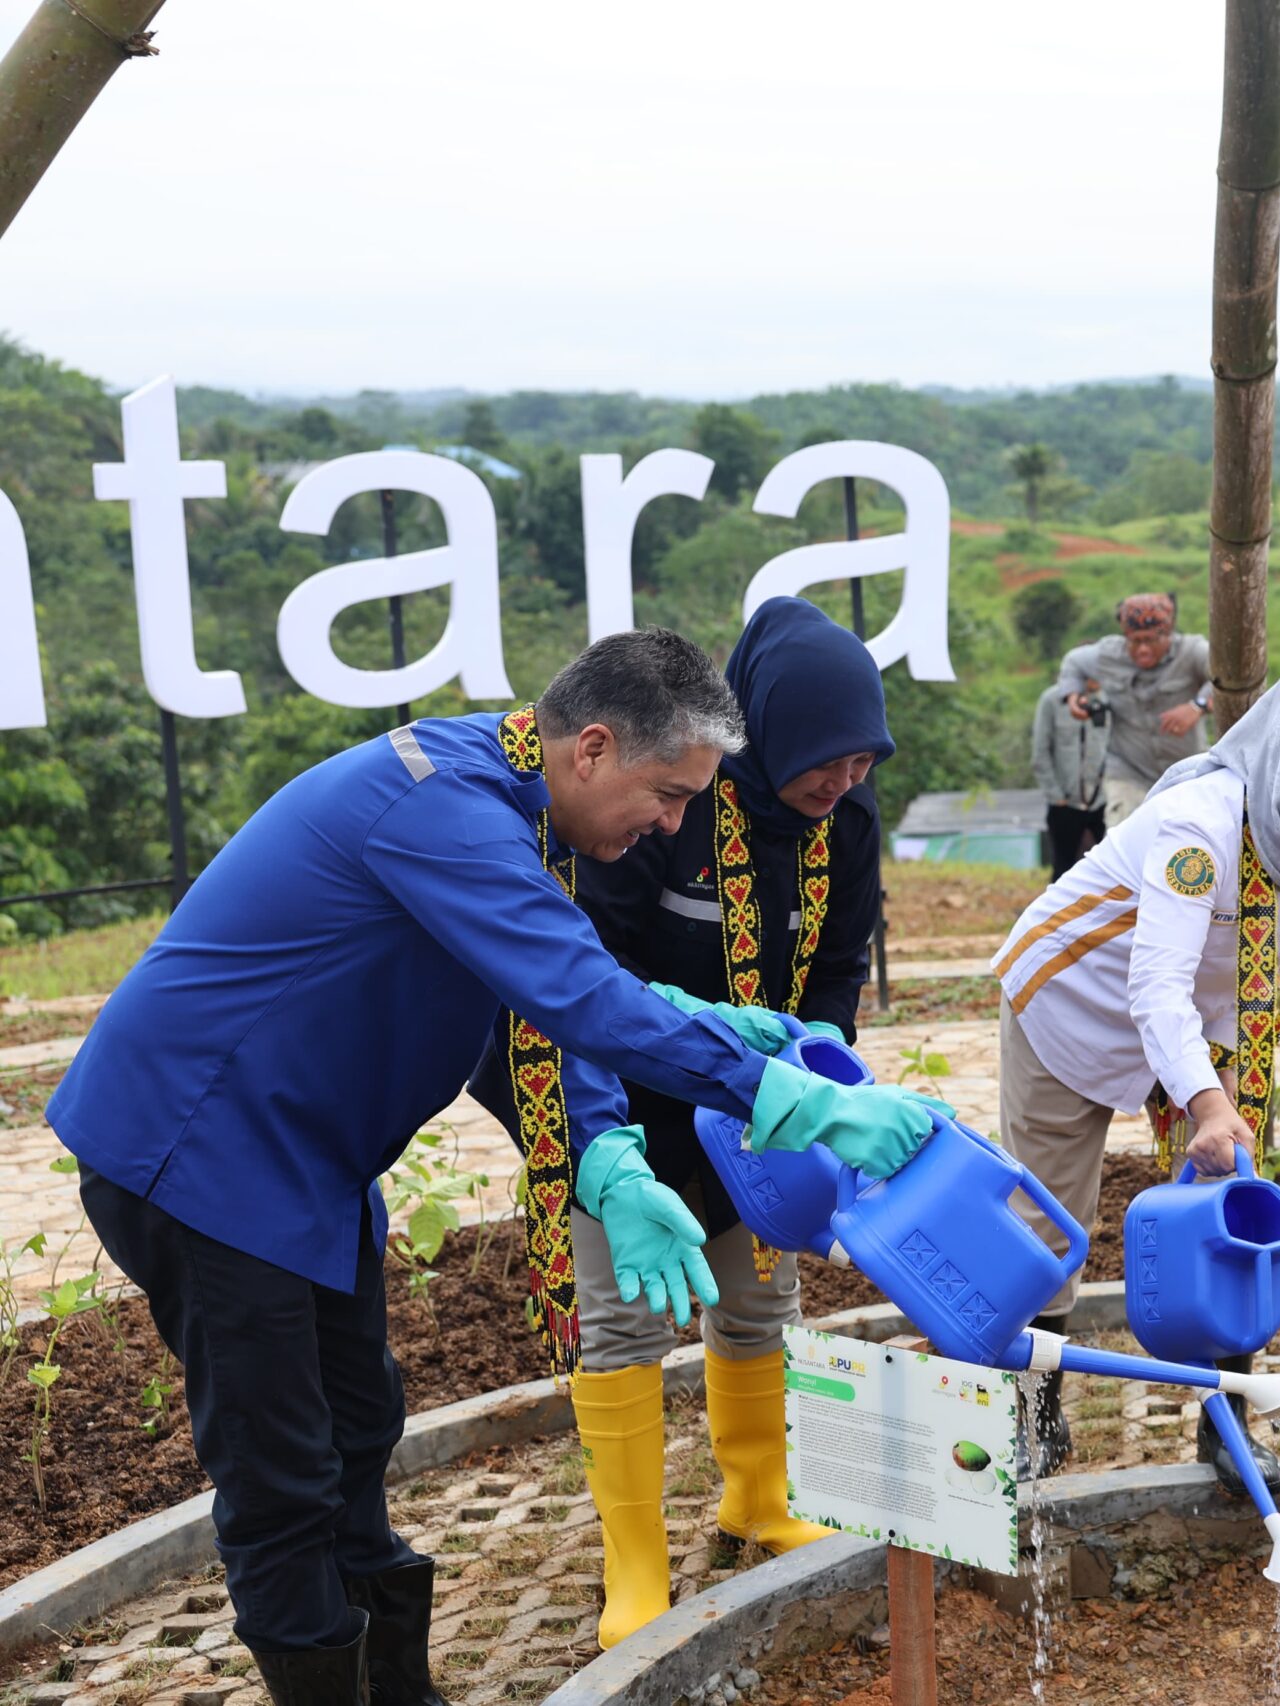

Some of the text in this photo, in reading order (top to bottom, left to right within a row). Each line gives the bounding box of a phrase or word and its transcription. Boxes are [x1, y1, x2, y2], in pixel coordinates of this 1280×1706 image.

[0, 374, 956, 731] tara
[1175, 848, 1214, 873] IBU KOTA
[1166, 867, 1211, 895] NUSANTARA
[977, 1399, 989, 1407] eni
